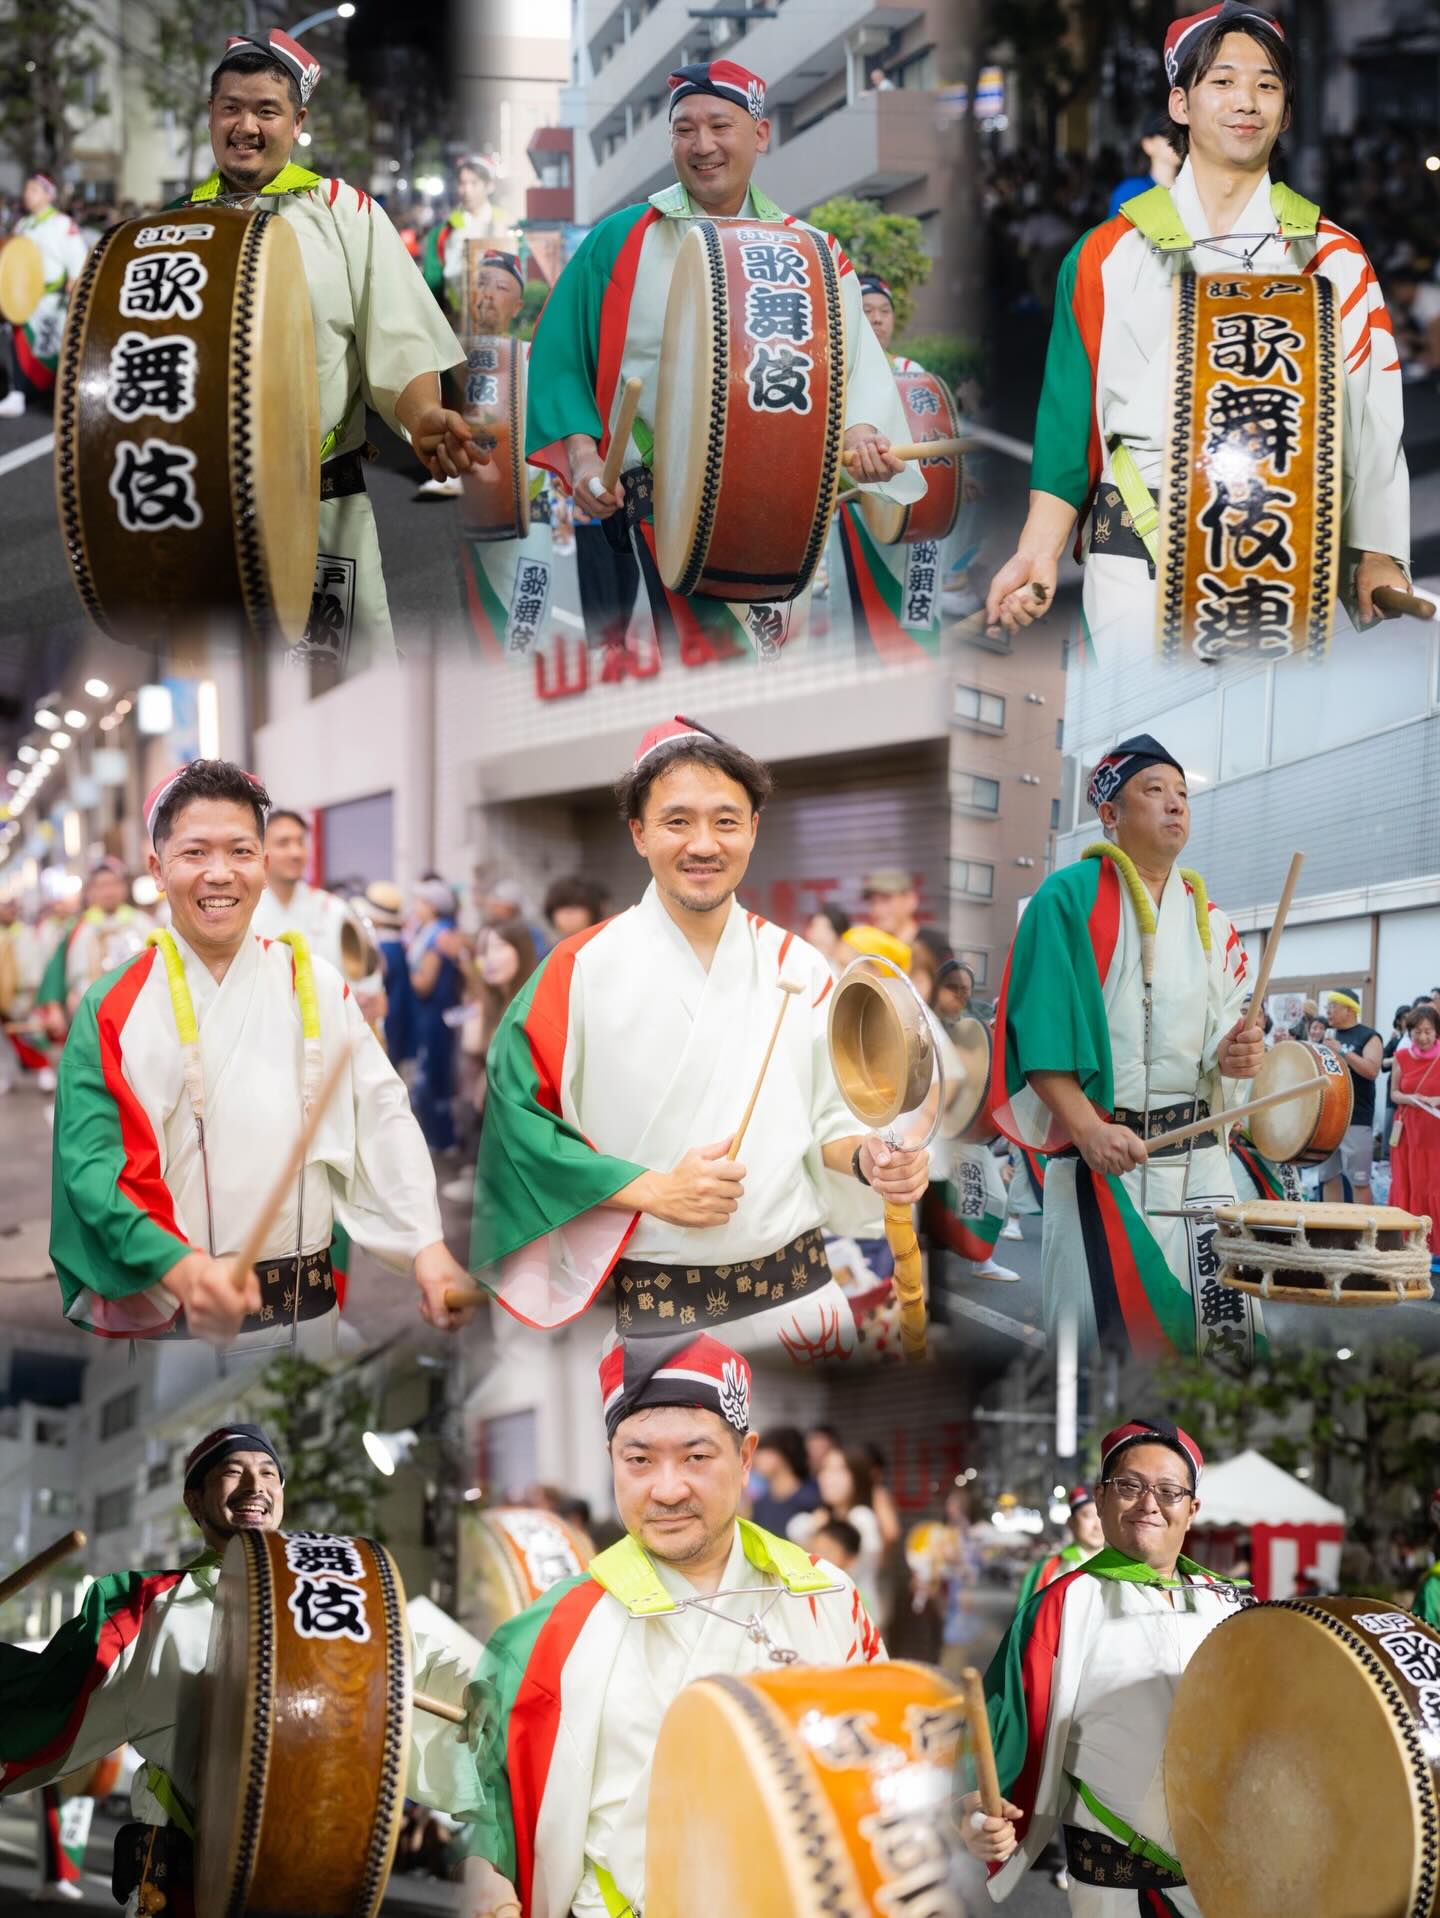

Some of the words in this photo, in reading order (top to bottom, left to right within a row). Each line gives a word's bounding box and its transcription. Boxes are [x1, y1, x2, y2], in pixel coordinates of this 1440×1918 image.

[134, 224, 216, 248] 江戸
[736, 229, 801, 243] 江戸
[739, 244, 815, 415] 歌舞伎
[1207, 281, 1305, 299] 江戸
[106, 252, 208, 532] 歌舞伎
[510, 566, 547, 653] 歌舞伎
[908, 540, 938, 622] 歌舞伎
